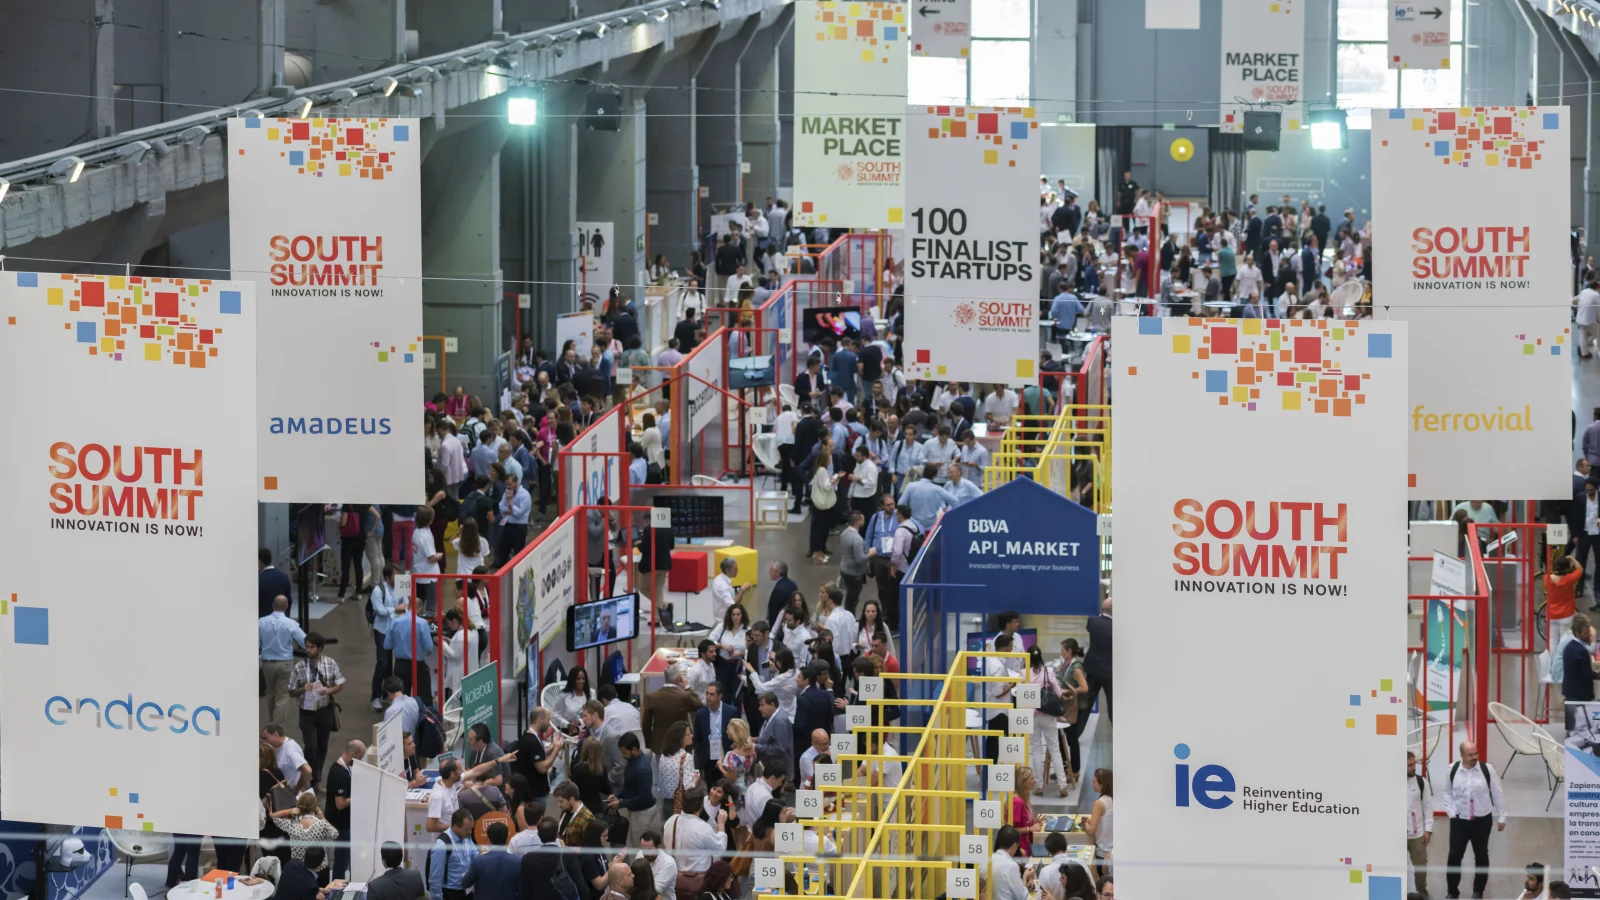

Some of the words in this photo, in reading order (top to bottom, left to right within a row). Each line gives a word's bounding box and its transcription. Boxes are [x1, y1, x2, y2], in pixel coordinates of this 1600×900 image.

[1226, 53, 1299, 66] MARKET
[1242, 68, 1299, 82] PLACE
[1266, 85, 1298, 93] SOUTH
[801, 117, 901, 136] MARKET
[824, 138, 901, 156] PLACE
[856, 161, 901, 172] SOUTH
[856, 172, 901, 182] SUMMIT
[911, 207, 967, 235] 100
[1412, 226, 1530, 254] SOUTH
[269, 235, 383, 262] SOUTH
[911, 238, 1028, 262] FINALIST
[911, 260, 1033, 282] STARTUPS
[1412, 255, 1530, 279] SUMMIT
[269, 263, 383, 286] SUMMIT
[1413, 281, 1482, 290] INNOVATION
[1486, 281, 1496, 289] IS
[1500, 280, 1530, 289] NOW!
[271, 288, 337, 297] INNOVATION
[341, 289, 351, 297] IS
[355, 289, 383, 297] NOW!
[978, 302, 1032, 316] SOUTH
[978, 315, 1032, 327] SUMMIT
[1411, 404, 1534, 432] ferrovial
[48, 441, 203, 487] SOUTH
[48, 481, 204, 521] SUMMIT
[656, 513, 666, 521] 19
[1172, 498, 1348, 543] SOUTH
[50, 517, 140, 534] INNOVATION
[145, 523, 159, 535] IS
[164, 524, 203, 537] NOW!
[968, 519, 1009, 534] BBVA
[968, 540, 1081, 558] API_MARKET
[969, 562, 1001, 570] Innovation
[1011, 564, 1036, 572] growing
[1172, 541, 1348, 580] SUMMIT
[400, 581, 410, 589] 20
[1174, 580, 1275, 595] INNOVATION
[1282, 583, 1297, 595] IS
[1303, 583, 1348, 597] NOW!
[865, 683, 877, 693] 87
[1023, 690, 1036, 700] 68
[44, 692, 221, 737] endesa
[852, 714, 865, 724] 69
[1016, 716, 1029, 726] 66
[837, 741, 850, 751] 67
[1006, 743, 1019, 753] 64
[823, 772, 836, 782] 65
[995, 771, 1009, 782] 62
[1173, 742, 1236, 810] ie
[1243, 786, 1323, 803] Reinventing
[803, 797, 818, 808] 63
[1243, 799, 1289, 813] Higher
[1292, 801, 1360, 816] Education
[980, 808, 994, 819] 60
[781, 831, 795, 842] 61
[968, 843, 983, 854] 58
[761, 867, 777, 877] 59
[955, 877, 970, 888] 56
